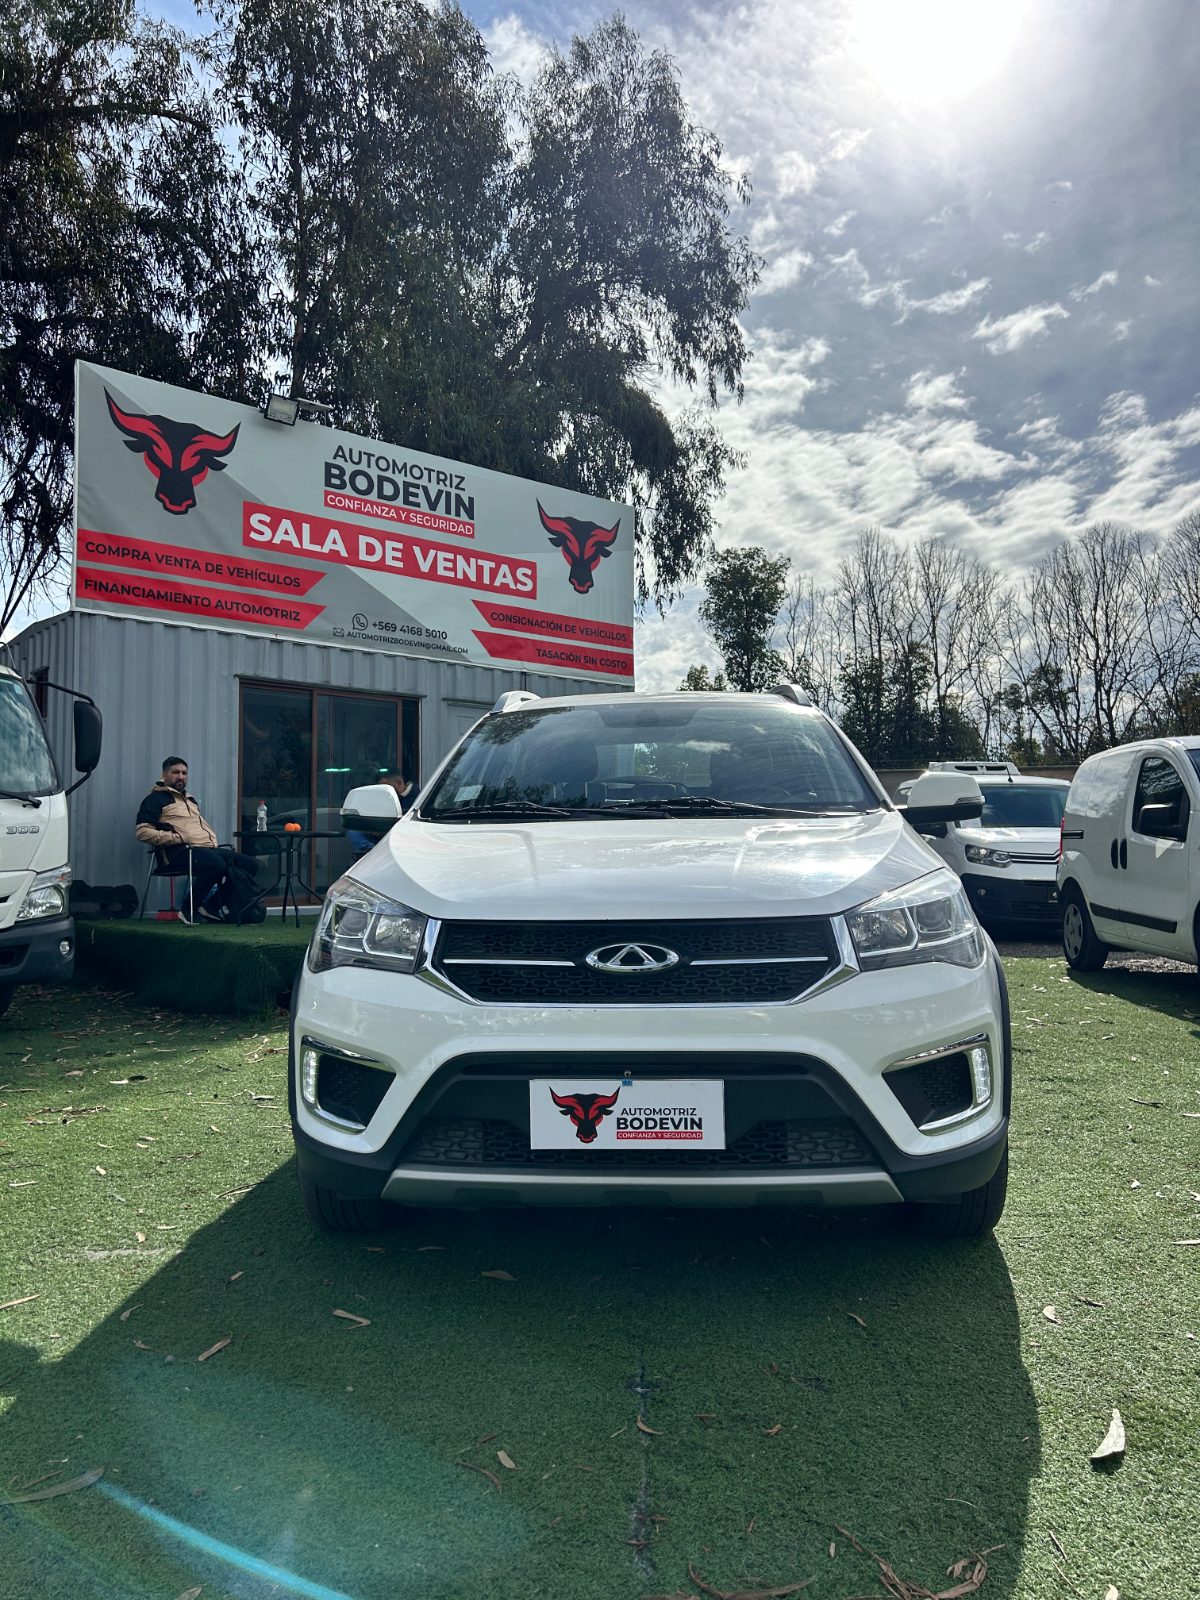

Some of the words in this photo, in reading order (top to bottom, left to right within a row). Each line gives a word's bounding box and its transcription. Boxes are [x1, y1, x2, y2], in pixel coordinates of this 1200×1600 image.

[332, 444, 466, 492] AUTOMOTRIZ
[324, 461, 475, 521] BODEVIN
[326, 494, 397, 519] CONFIANZA
[399, 508, 407, 520] Y
[409, 513, 473, 536] SEGURIDAD
[85, 541, 151, 562] COMPRA
[155, 553, 201, 571] VENTA
[205, 561, 223, 575] DE
[227, 565, 301, 588] VEHÍCULOS
[249, 513, 349, 559] SALA
[358, 534, 404, 568] DE
[412, 546, 534, 593] VENTAS
[84, 579, 211, 607] FINANCIAMIENTO
[214, 599, 301, 622] AUTOMOTRIZ
[372, 621, 397, 633] +569
[399, 625, 423, 637] 4168
[425, 628, 448, 640] 5010
[490, 611, 563, 632] CONSIGNACIÓN
[565, 624, 577, 634] DE
[579, 626, 627, 642] VEHÍCULOS
[536, 648, 582, 664] TASACIÓN
[584, 655, 597, 666] SIN
[599, 657, 628, 670] COSTO
[6, 825, 40, 835] 300
[616, 1117, 703, 1130] BODEVIN
[621, 1107, 697, 1116] AUTOMOTRIZ
